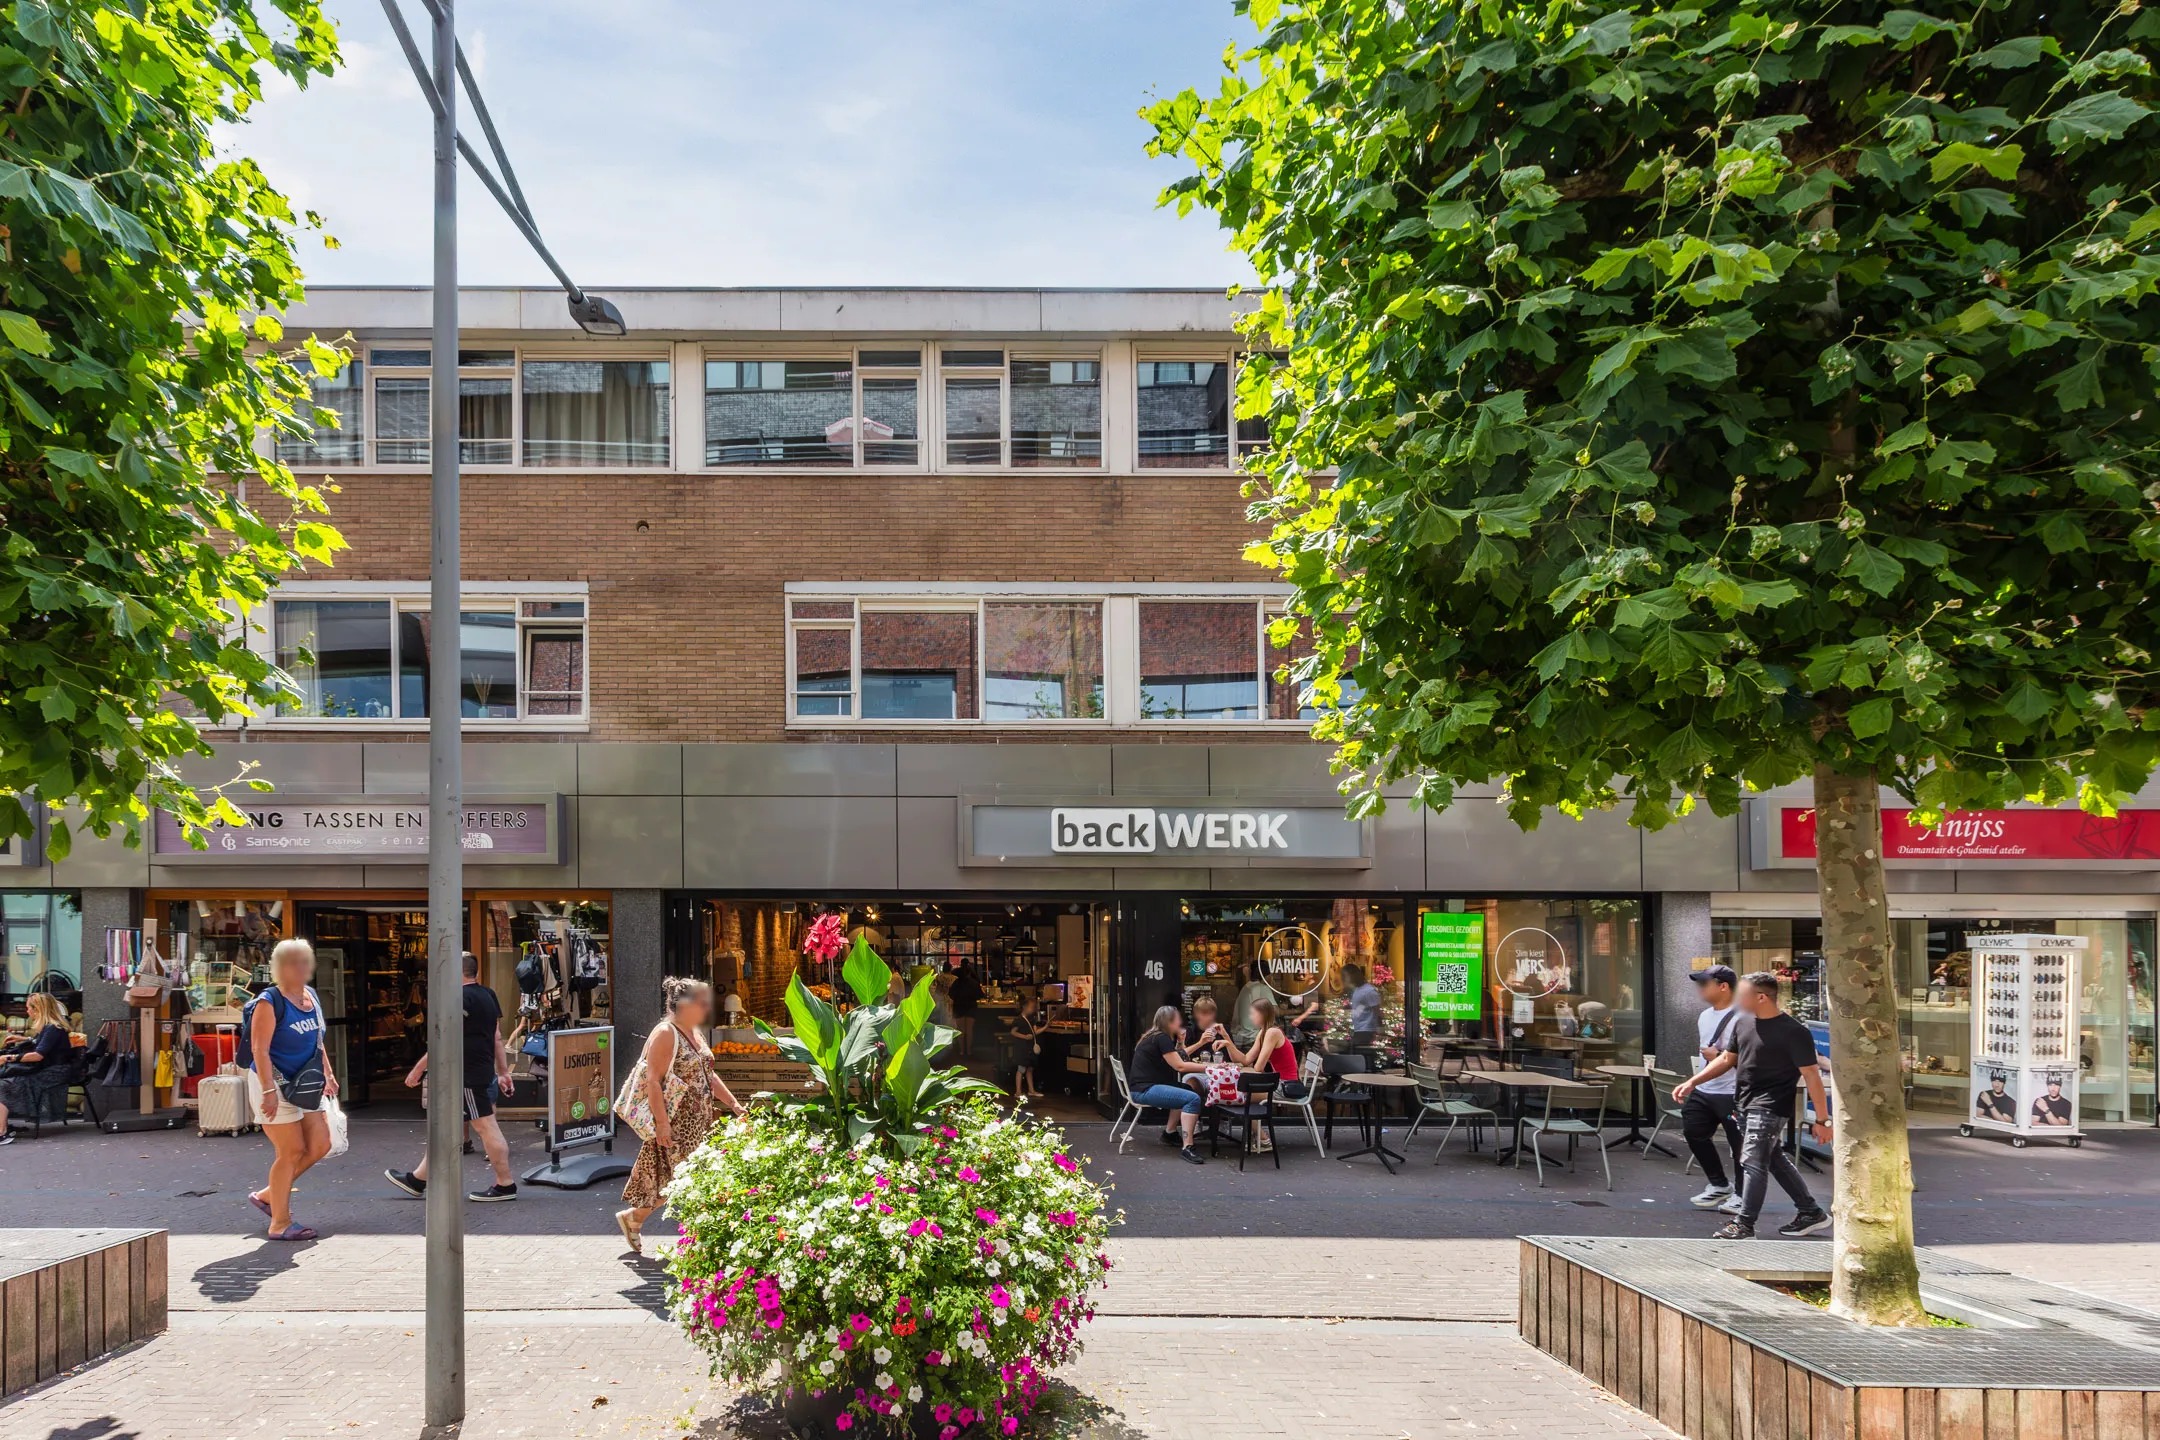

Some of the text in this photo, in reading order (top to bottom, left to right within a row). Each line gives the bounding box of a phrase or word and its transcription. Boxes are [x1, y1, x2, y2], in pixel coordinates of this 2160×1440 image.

[216, 812, 284, 828] JNG
[303, 812, 383, 828] TASSEN
[395, 812, 422, 828] EN
[461, 812, 527, 828] FFERS
[246, 836, 311, 848] Samsonite
[1999, 845, 2026, 855] atelier
[1979, 938, 2014, 947] OLYMPIC
[2040, 938, 2075, 947] OLYMPIC
[1279, 948, 1307, 957] Slim kiest
[1515, 949, 1545, 958] Slim kiest
[1144, 960, 1164, 980] 46
[1268, 958, 1319, 974] VARIATIE
[289, 1018, 319, 1035] VOIL
[563, 1052, 602, 1070] IJSKOFFIE
